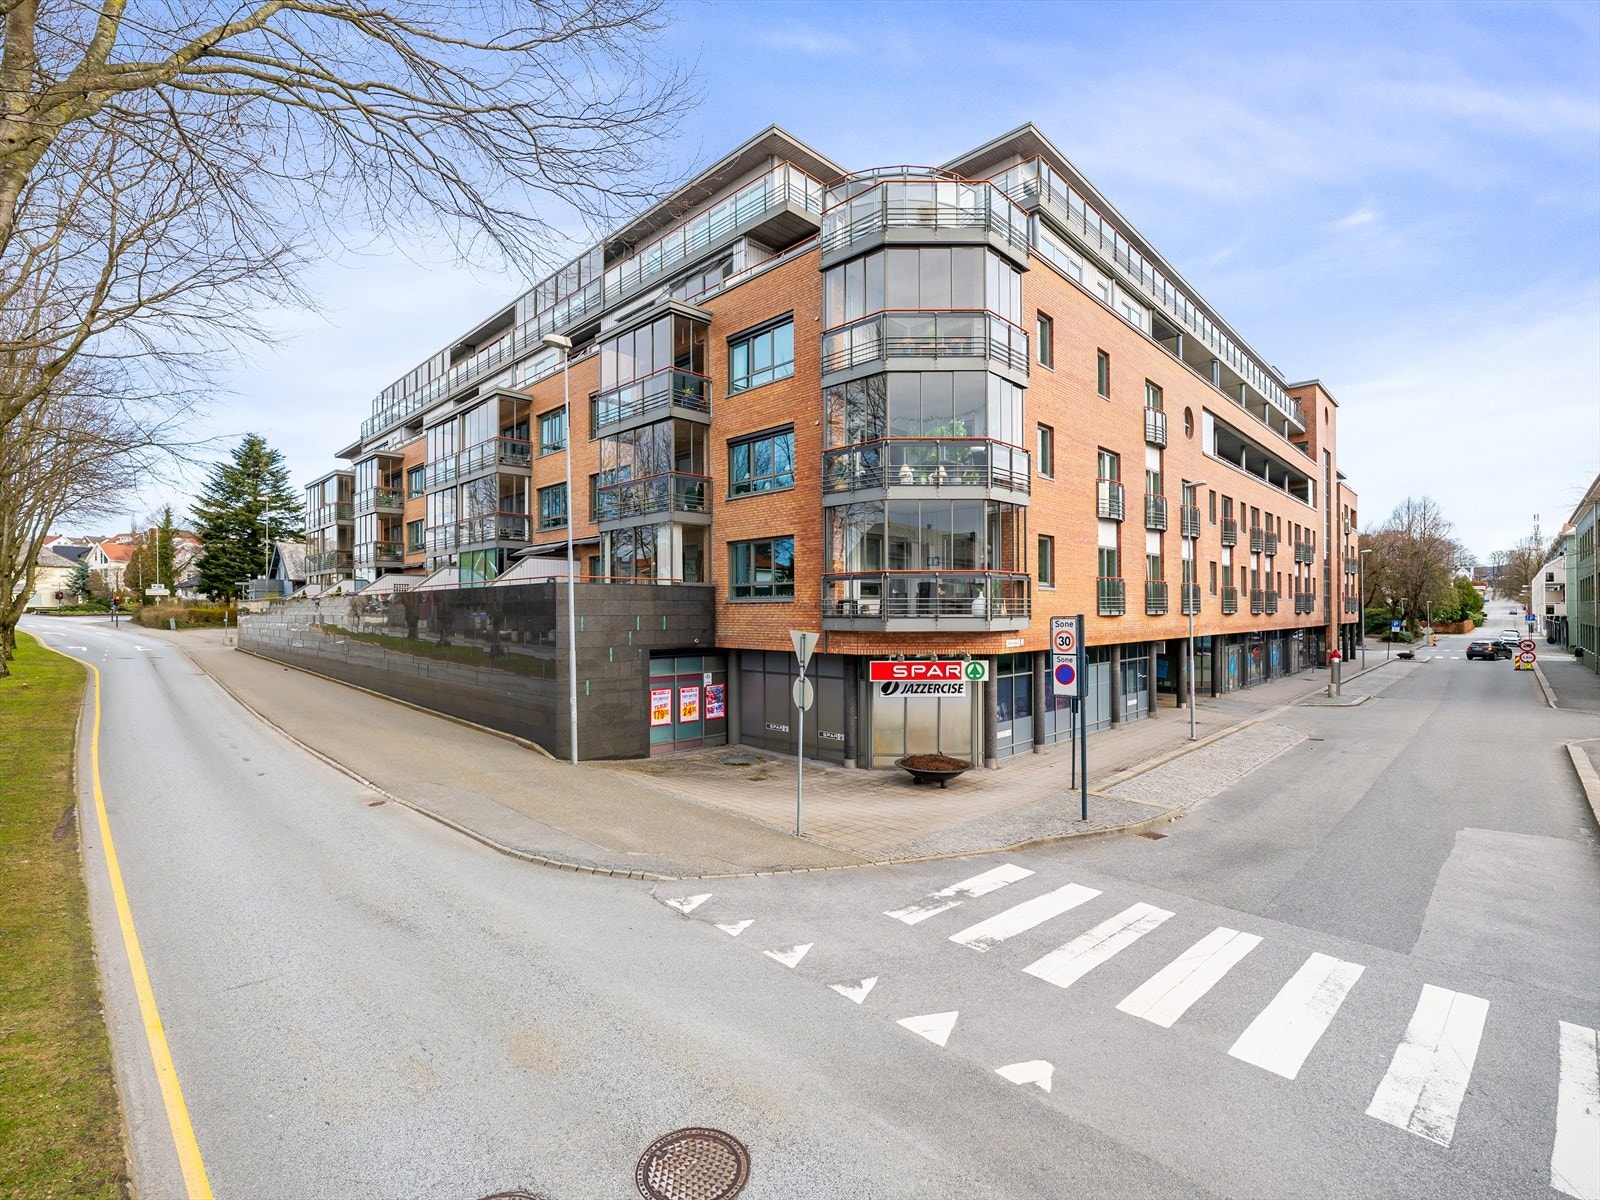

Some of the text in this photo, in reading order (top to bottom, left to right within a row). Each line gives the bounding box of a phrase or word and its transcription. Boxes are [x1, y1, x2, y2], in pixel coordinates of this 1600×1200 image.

[1055, 620, 1074, 628] Sone
[1058, 636, 1071, 646] 30
[893, 665, 961, 677] SPAR
[900, 683, 964, 694] JAZZERCISE
